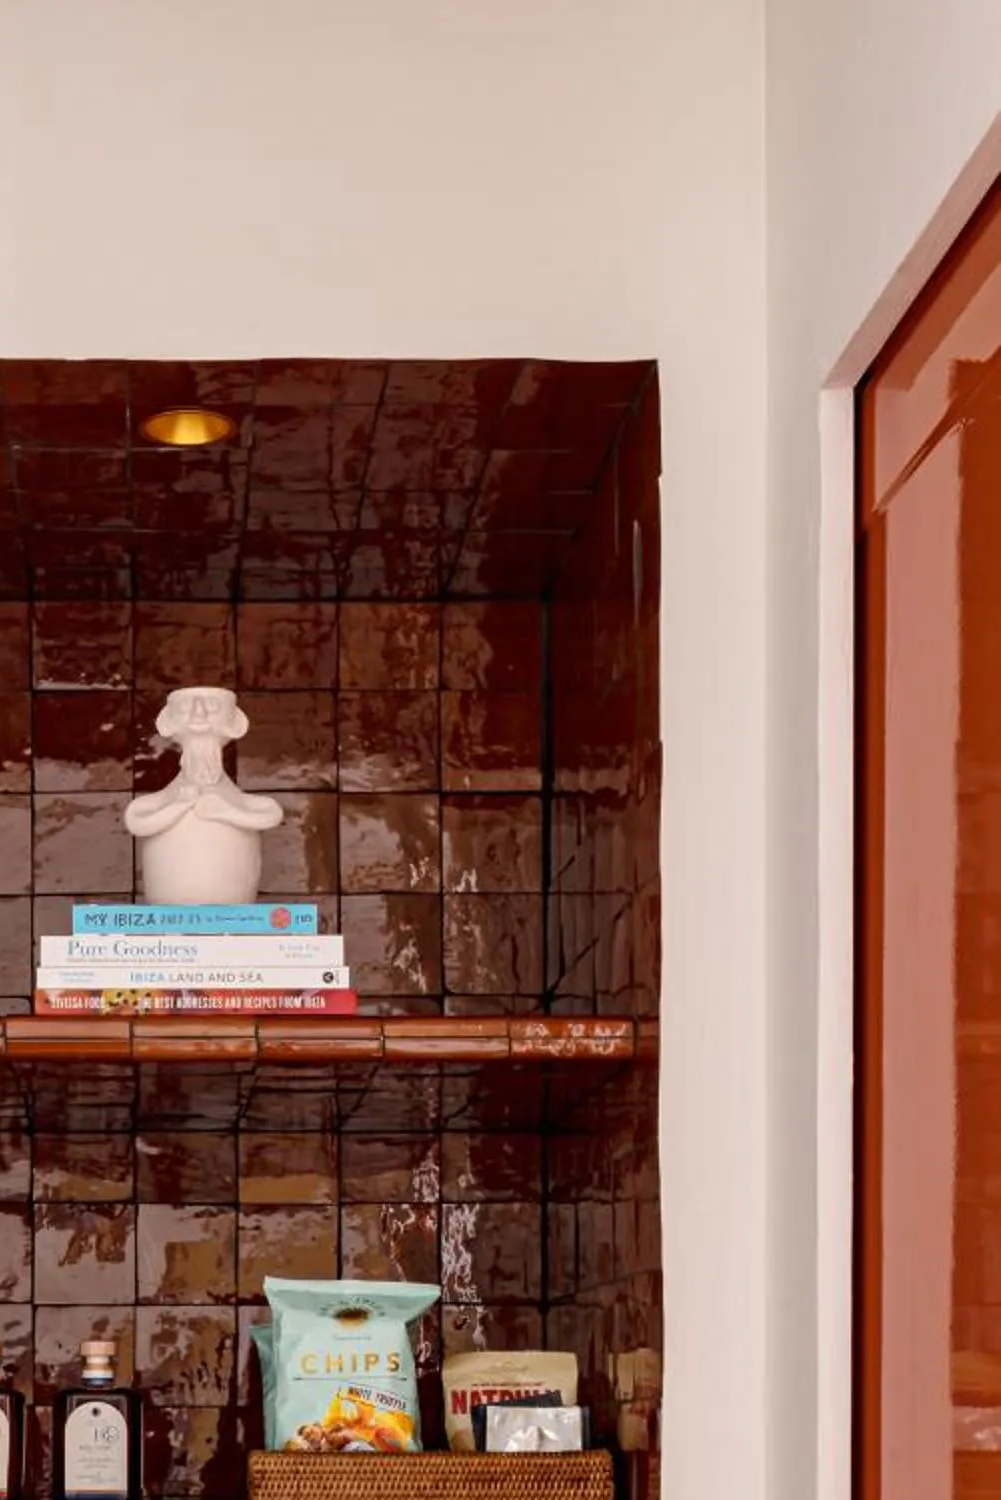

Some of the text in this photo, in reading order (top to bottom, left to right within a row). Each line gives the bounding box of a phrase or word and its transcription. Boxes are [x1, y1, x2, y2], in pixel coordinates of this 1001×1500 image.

[84, 911, 108, 927] MY
[113, 911, 157, 928] IBIZA
[67, 938, 199, 958] Pure Goodness
[129, 971, 264, 983] IBIZA LAND AND SEA
[301, 1351, 401, 1375] CHIPS
